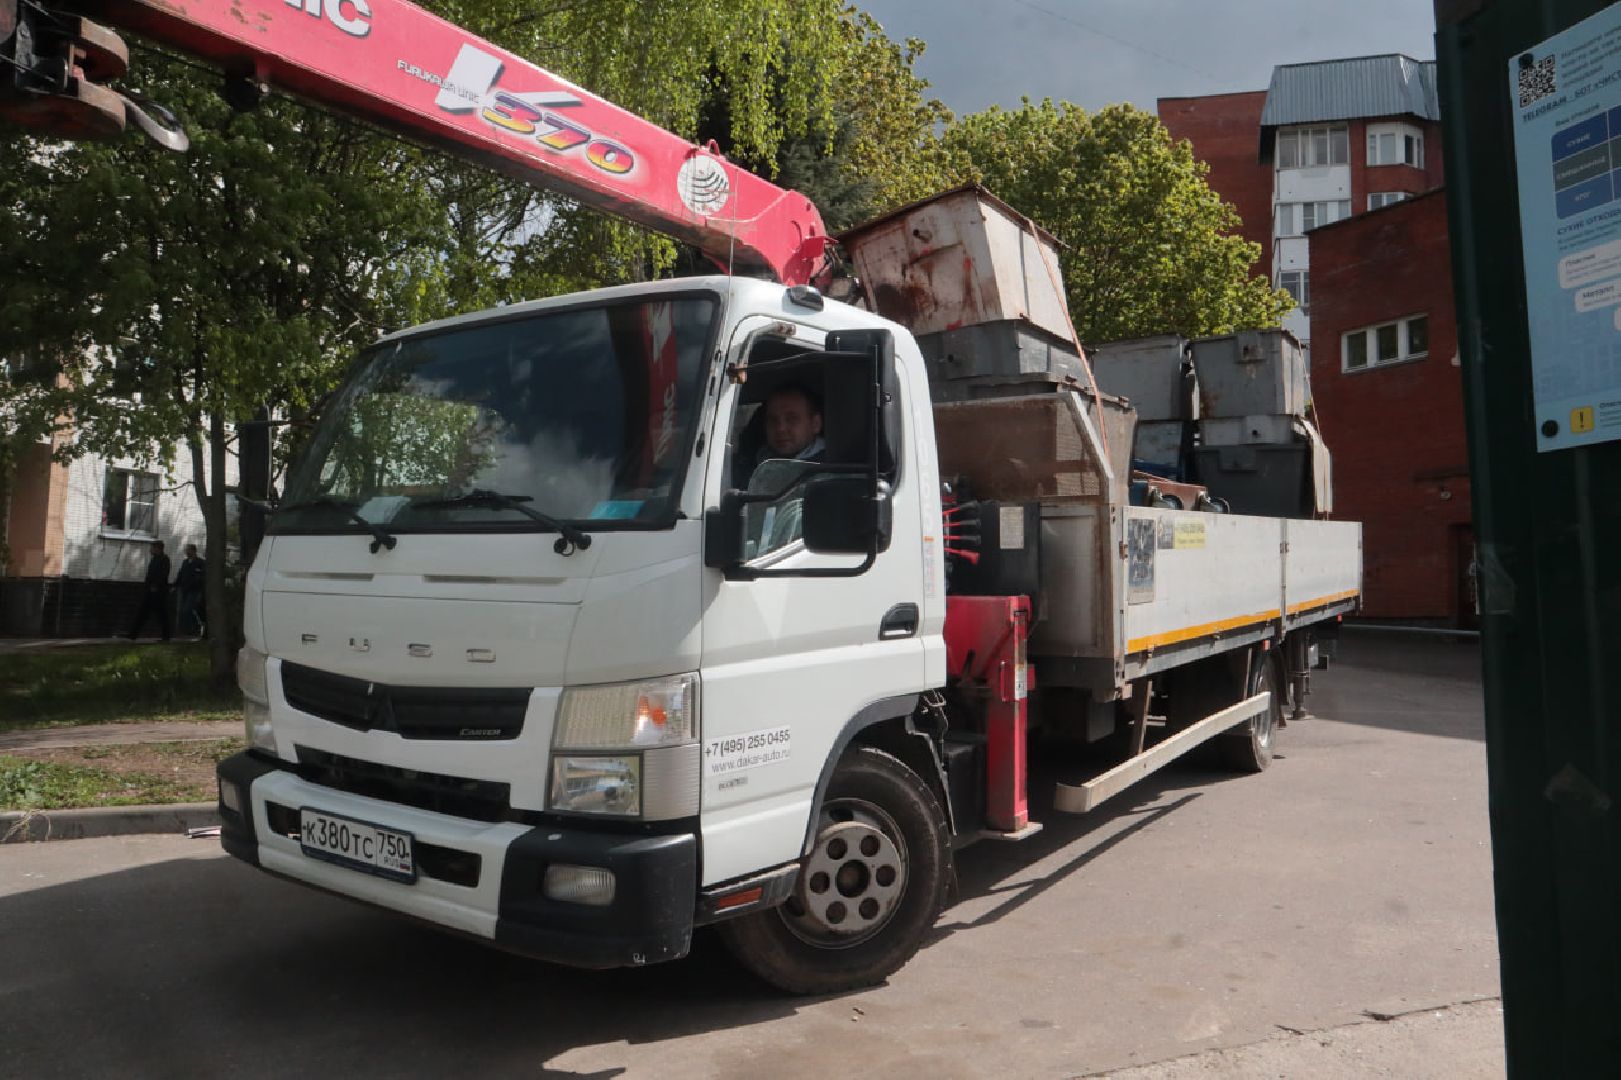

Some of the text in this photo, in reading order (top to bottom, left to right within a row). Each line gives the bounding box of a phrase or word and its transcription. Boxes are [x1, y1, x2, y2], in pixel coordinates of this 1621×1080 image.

[301, 633, 496, 663] FUSO
[720, 738, 746, 757] (495)
[747, 734, 765, 749] 255
[767, 729, 791, 745] 0455
[376, 832, 407, 859] 750
